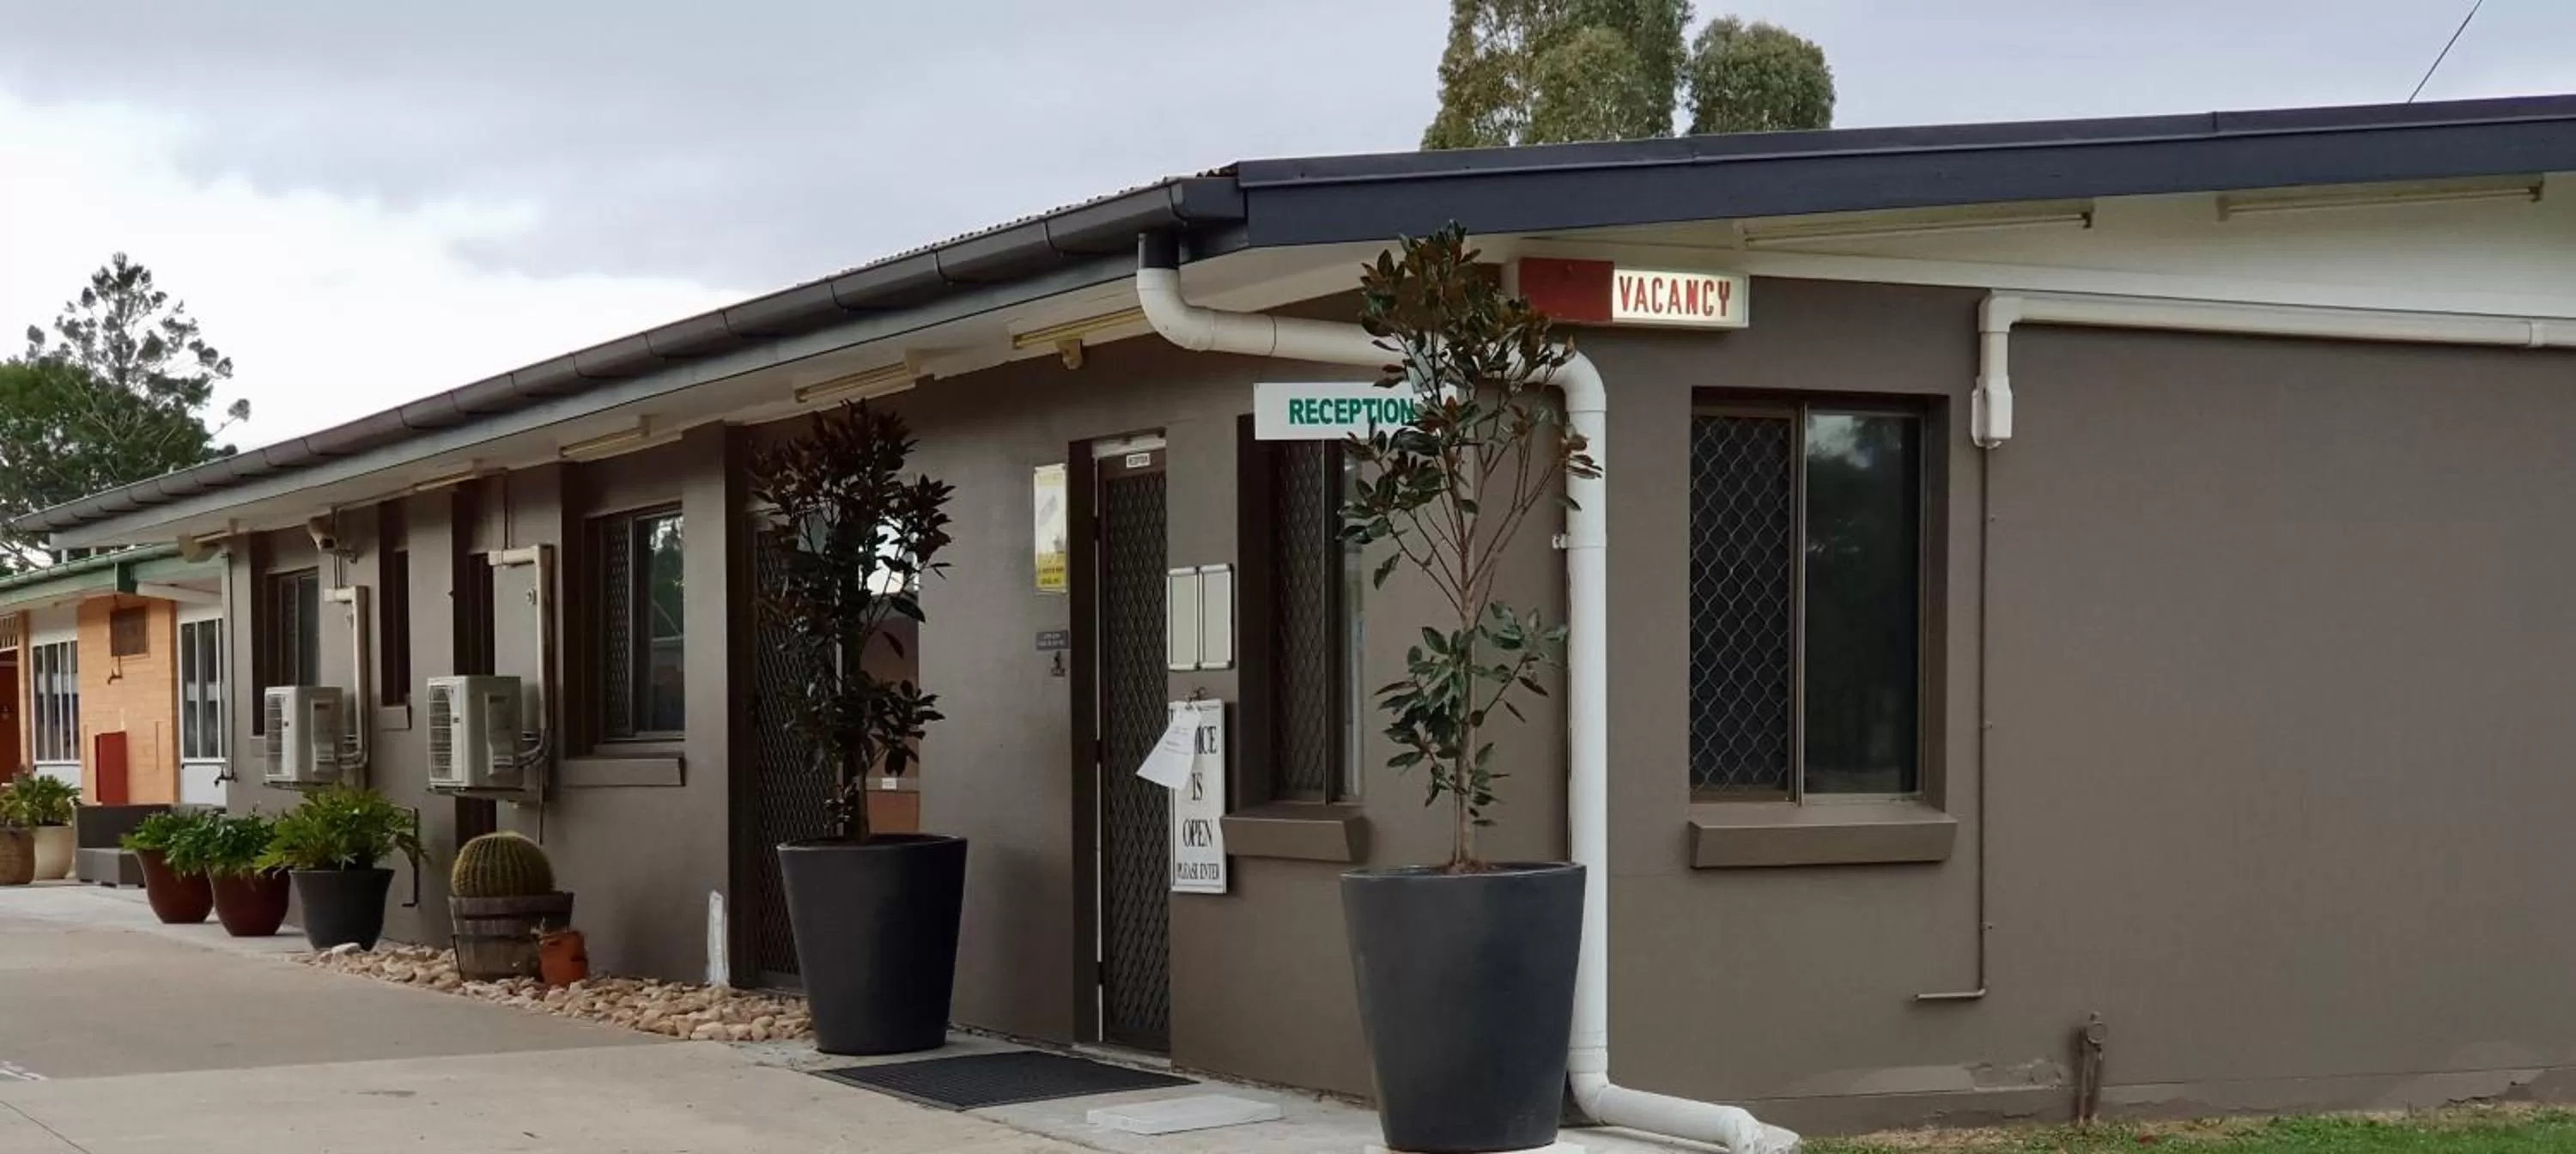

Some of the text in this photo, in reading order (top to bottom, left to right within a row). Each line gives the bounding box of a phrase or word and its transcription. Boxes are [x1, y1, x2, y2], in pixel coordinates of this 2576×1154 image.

[1619, 276, 1732, 317] VACANCY
[1289, 398, 1415, 425] RECEPTION
[1194, 726, 1217, 754] ICE
[1192, 773, 1203, 800] IS
[1182, 819, 1213, 847] OPEN
[1177, 863, 1219, 880] PLEASE ENTER
